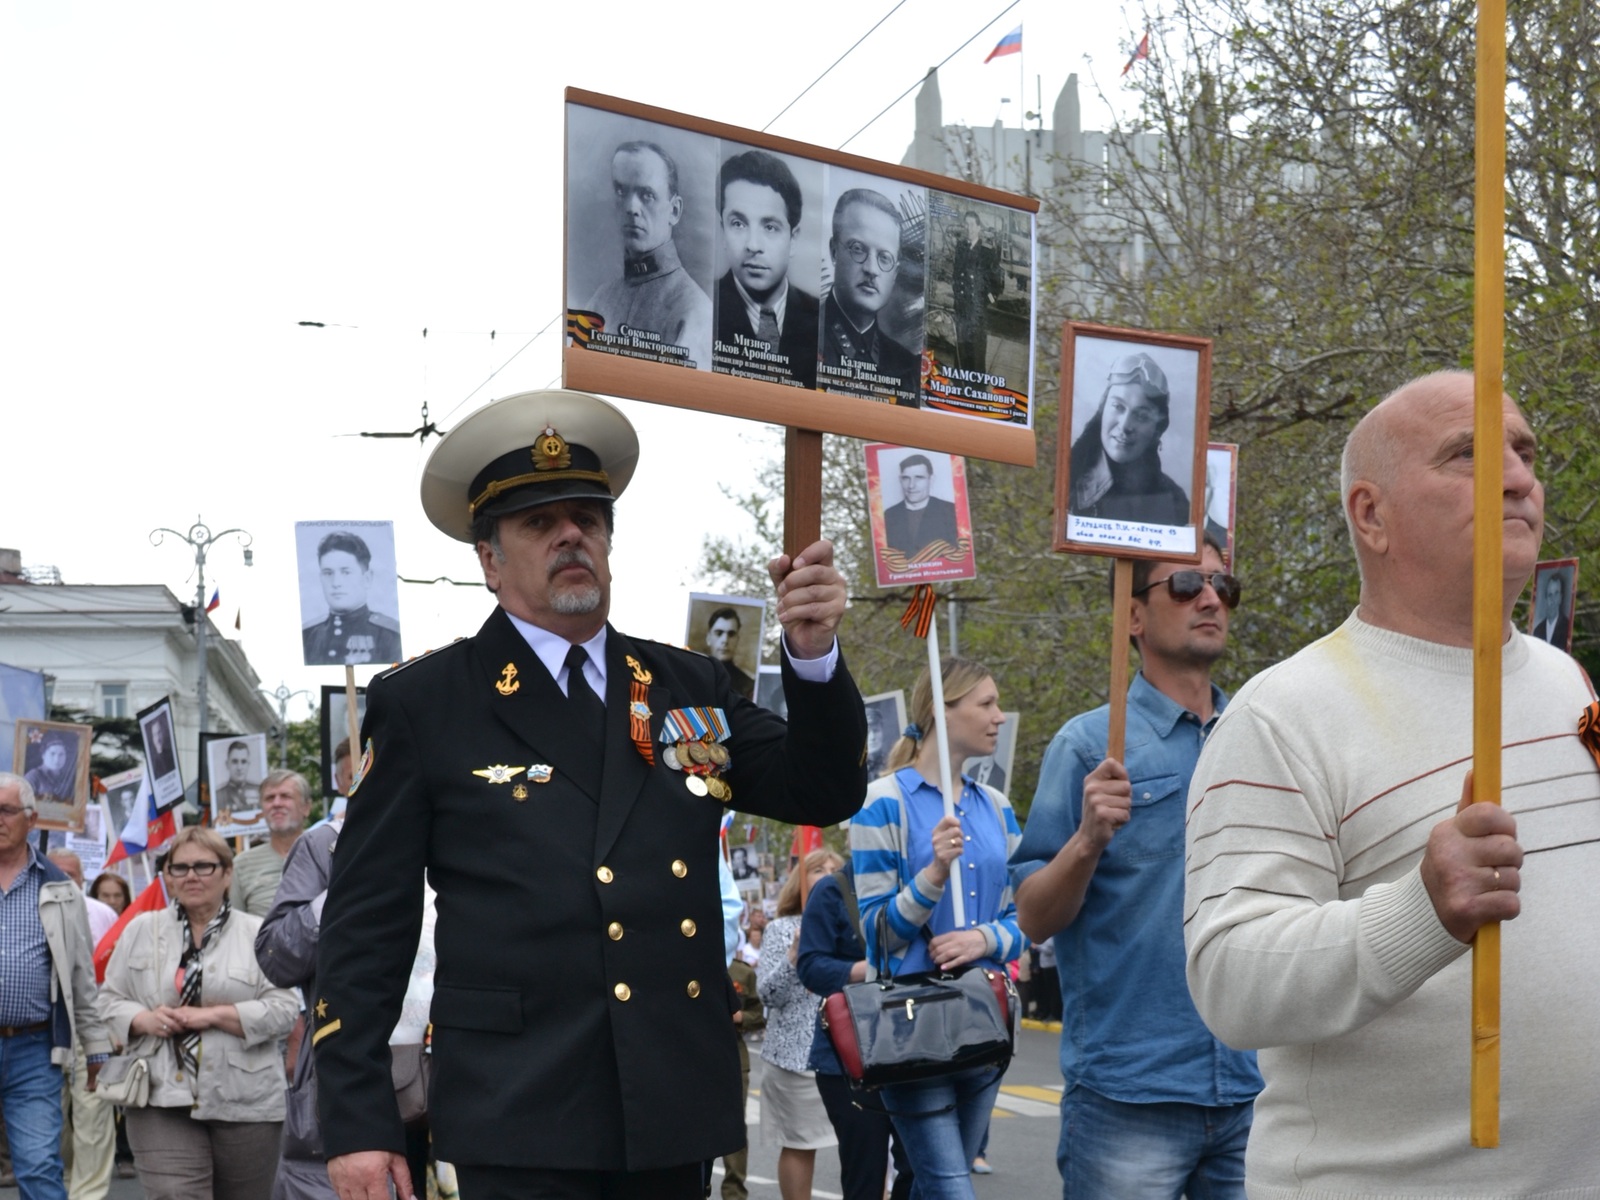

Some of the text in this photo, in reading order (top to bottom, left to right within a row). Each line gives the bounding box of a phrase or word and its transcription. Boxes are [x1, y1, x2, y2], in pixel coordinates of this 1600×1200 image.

[590, 329, 690, 357] Георгий Викторович
[620, 324, 661, 342] Соколов
[733, 333, 771, 353] Мизнер
[714, 340, 790, 365] Яков Аронович
[841, 355, 878, 371] Калачик
[853, 369, 901, 386] Давыдович
[941, 366, 1005, 387] МАМСУРОВ
[930, 380, 1016, 405] Марат Саханович
